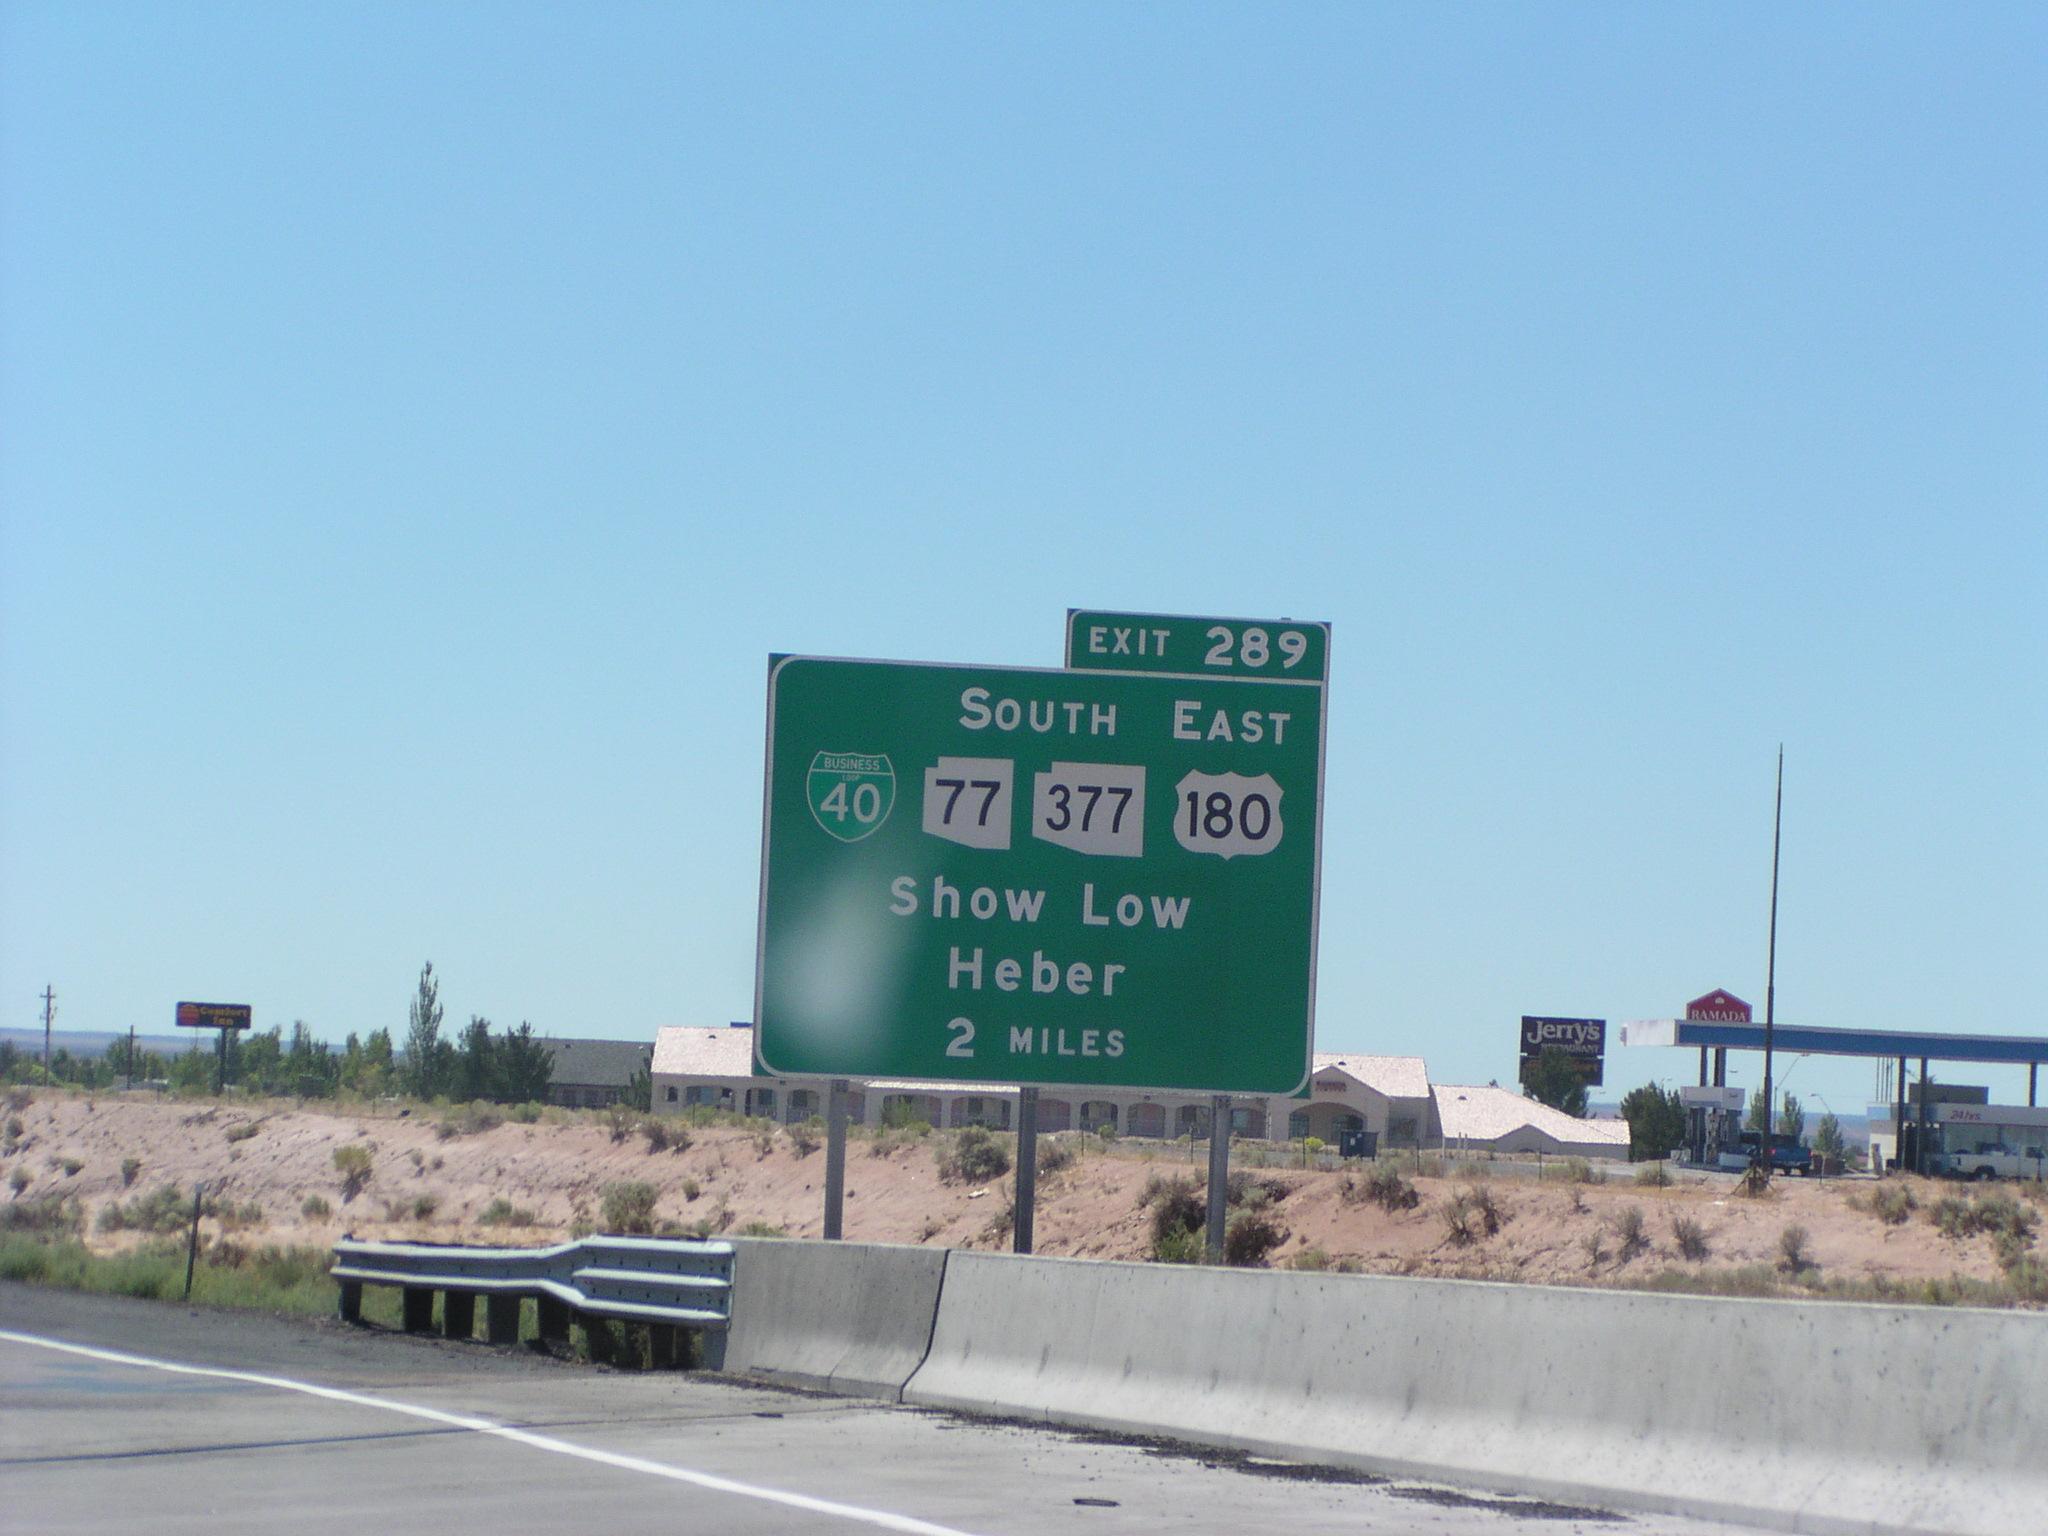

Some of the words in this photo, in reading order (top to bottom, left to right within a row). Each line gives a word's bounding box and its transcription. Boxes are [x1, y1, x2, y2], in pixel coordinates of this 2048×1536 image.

[1089, 627, 1171, 656] EXIT
[1205, 626, 1307, 669] 289
[959, 687, 1117, 736] SOUTH
[1173, 700, 1291, 745] EAST
[824, 757, 881, 771] BUSINESS
[820, 782, 881, 823] 40
[935, 779, 1001, 826] 77
[1045, 784, 1133, 834] 377
[1186, 790, 1272, 840] 180
[889, 876, 1046, 923] Show
[1083, 883, 1192, 929] Low
[948, 946, 1126, 996] Heber
[945, 1018, 976, 1058] 2
[1009, 1026, 1126, 1057] MILES
[1526, 1021, 1601, 1045] Jerry's
[1691, 1009, 1747, 1022] RAMADA
